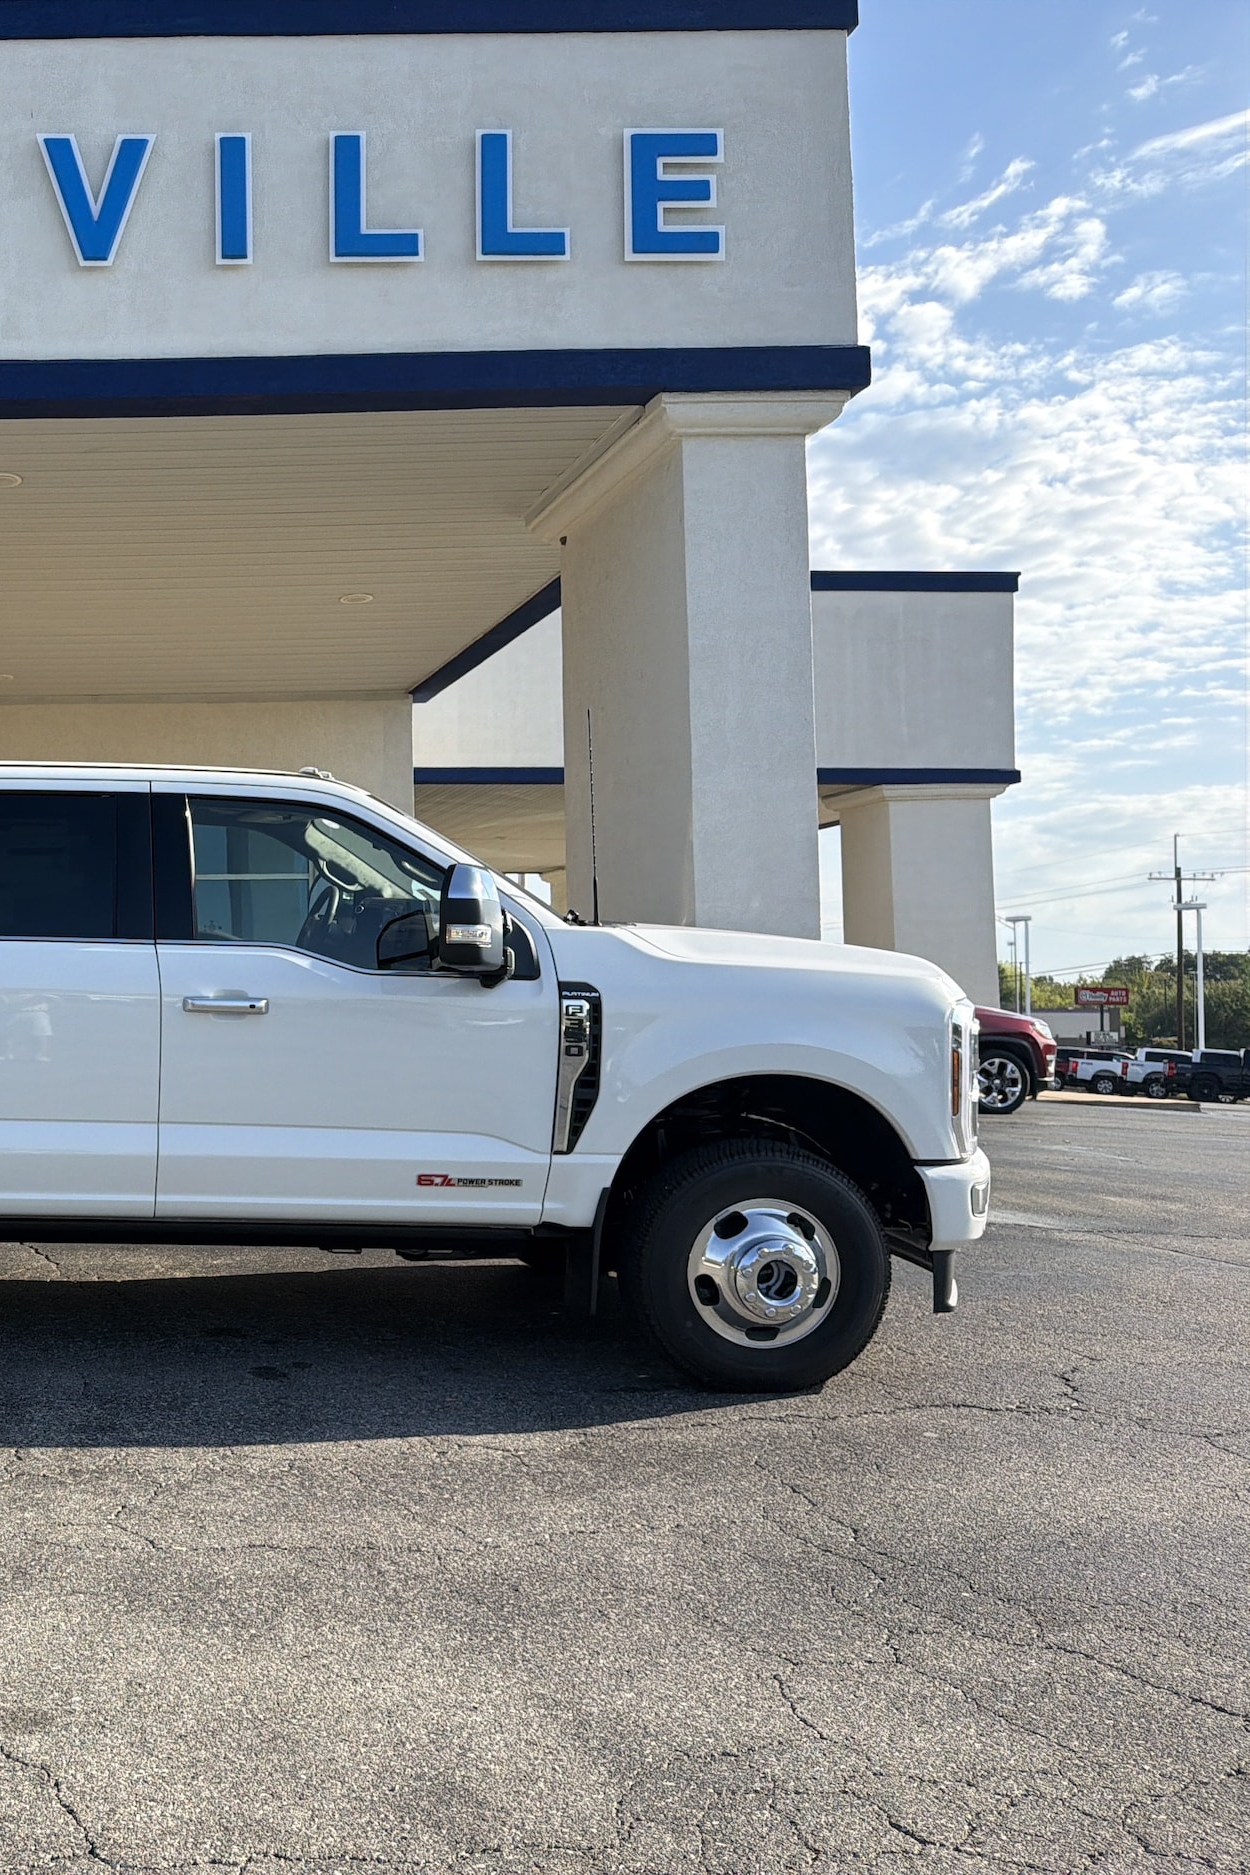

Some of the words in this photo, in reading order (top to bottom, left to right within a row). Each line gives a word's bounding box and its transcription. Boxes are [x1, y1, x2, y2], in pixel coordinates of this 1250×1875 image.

[416, 1174, 456, 1187] 6.7L
[457, 1178, 486, 1186] POWER
[488, 1178, 522, 1187] STROKE
